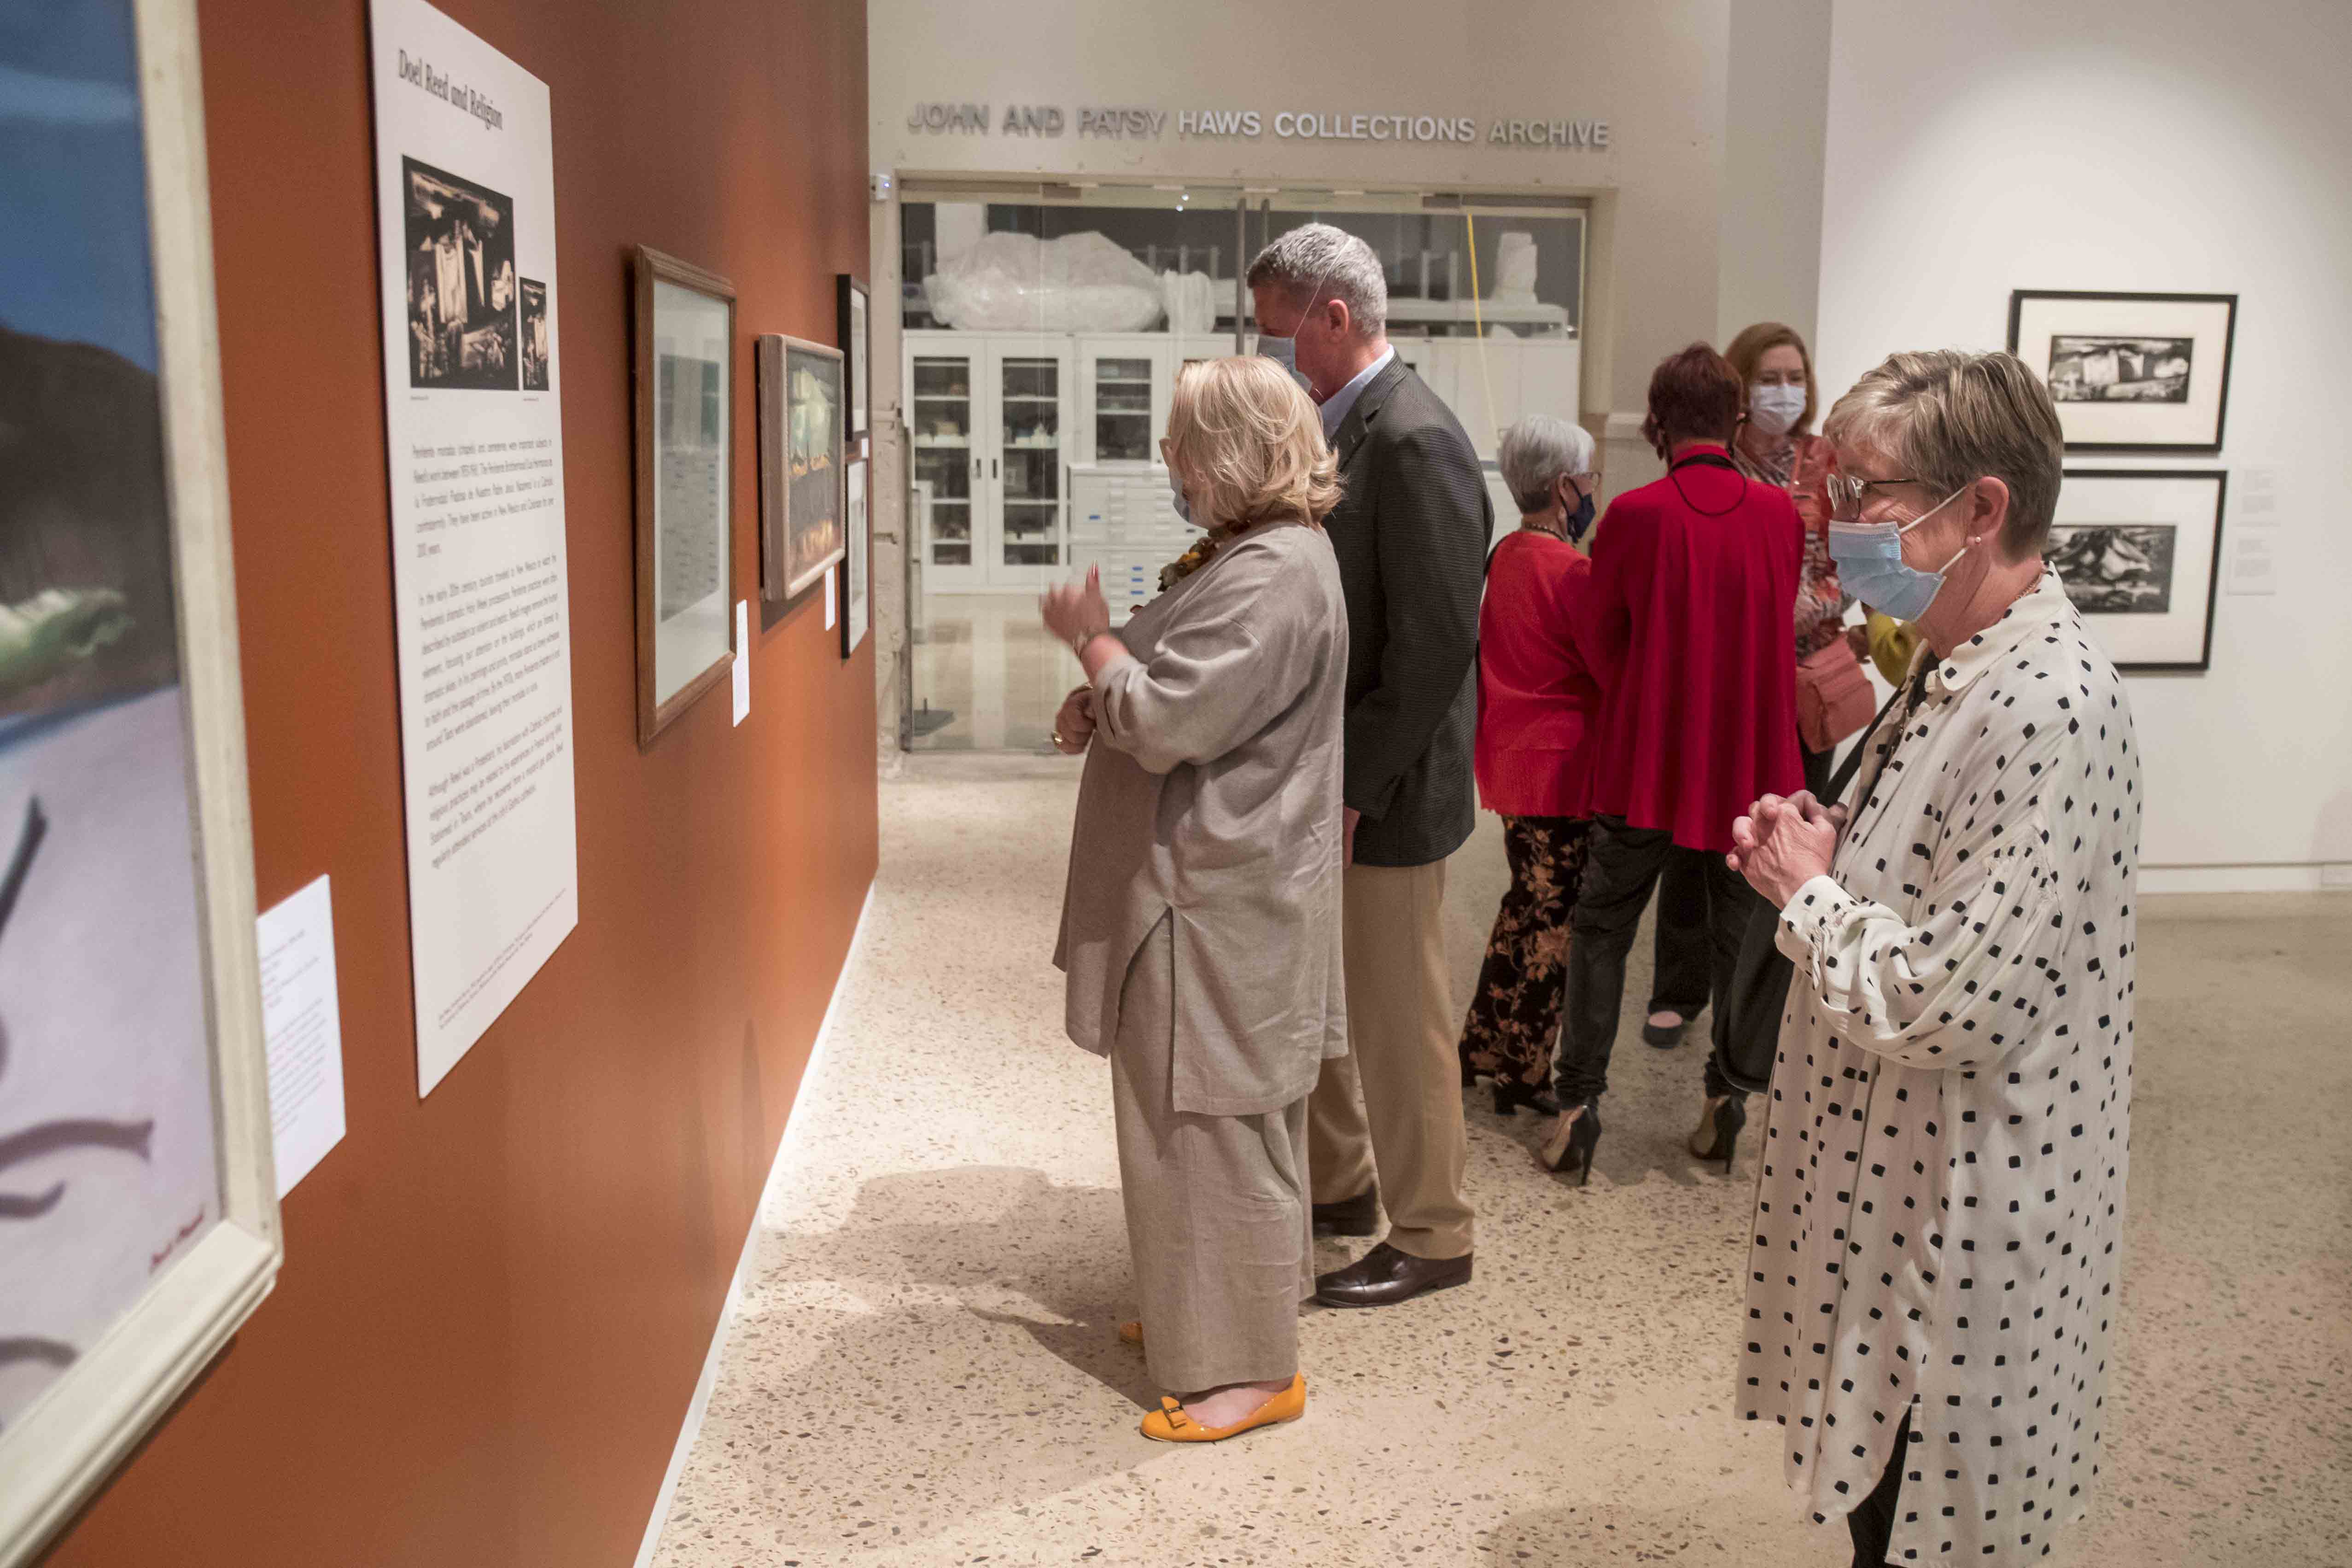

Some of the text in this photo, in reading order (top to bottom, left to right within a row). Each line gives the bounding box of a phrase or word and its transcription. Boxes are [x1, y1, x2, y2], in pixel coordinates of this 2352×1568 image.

[398, 49, 502, 130] Doel Reed and Religion
[908, 104, 1609, 146] JOHN AND PATSY HAWS COLLECTIONS ARCHIVE
